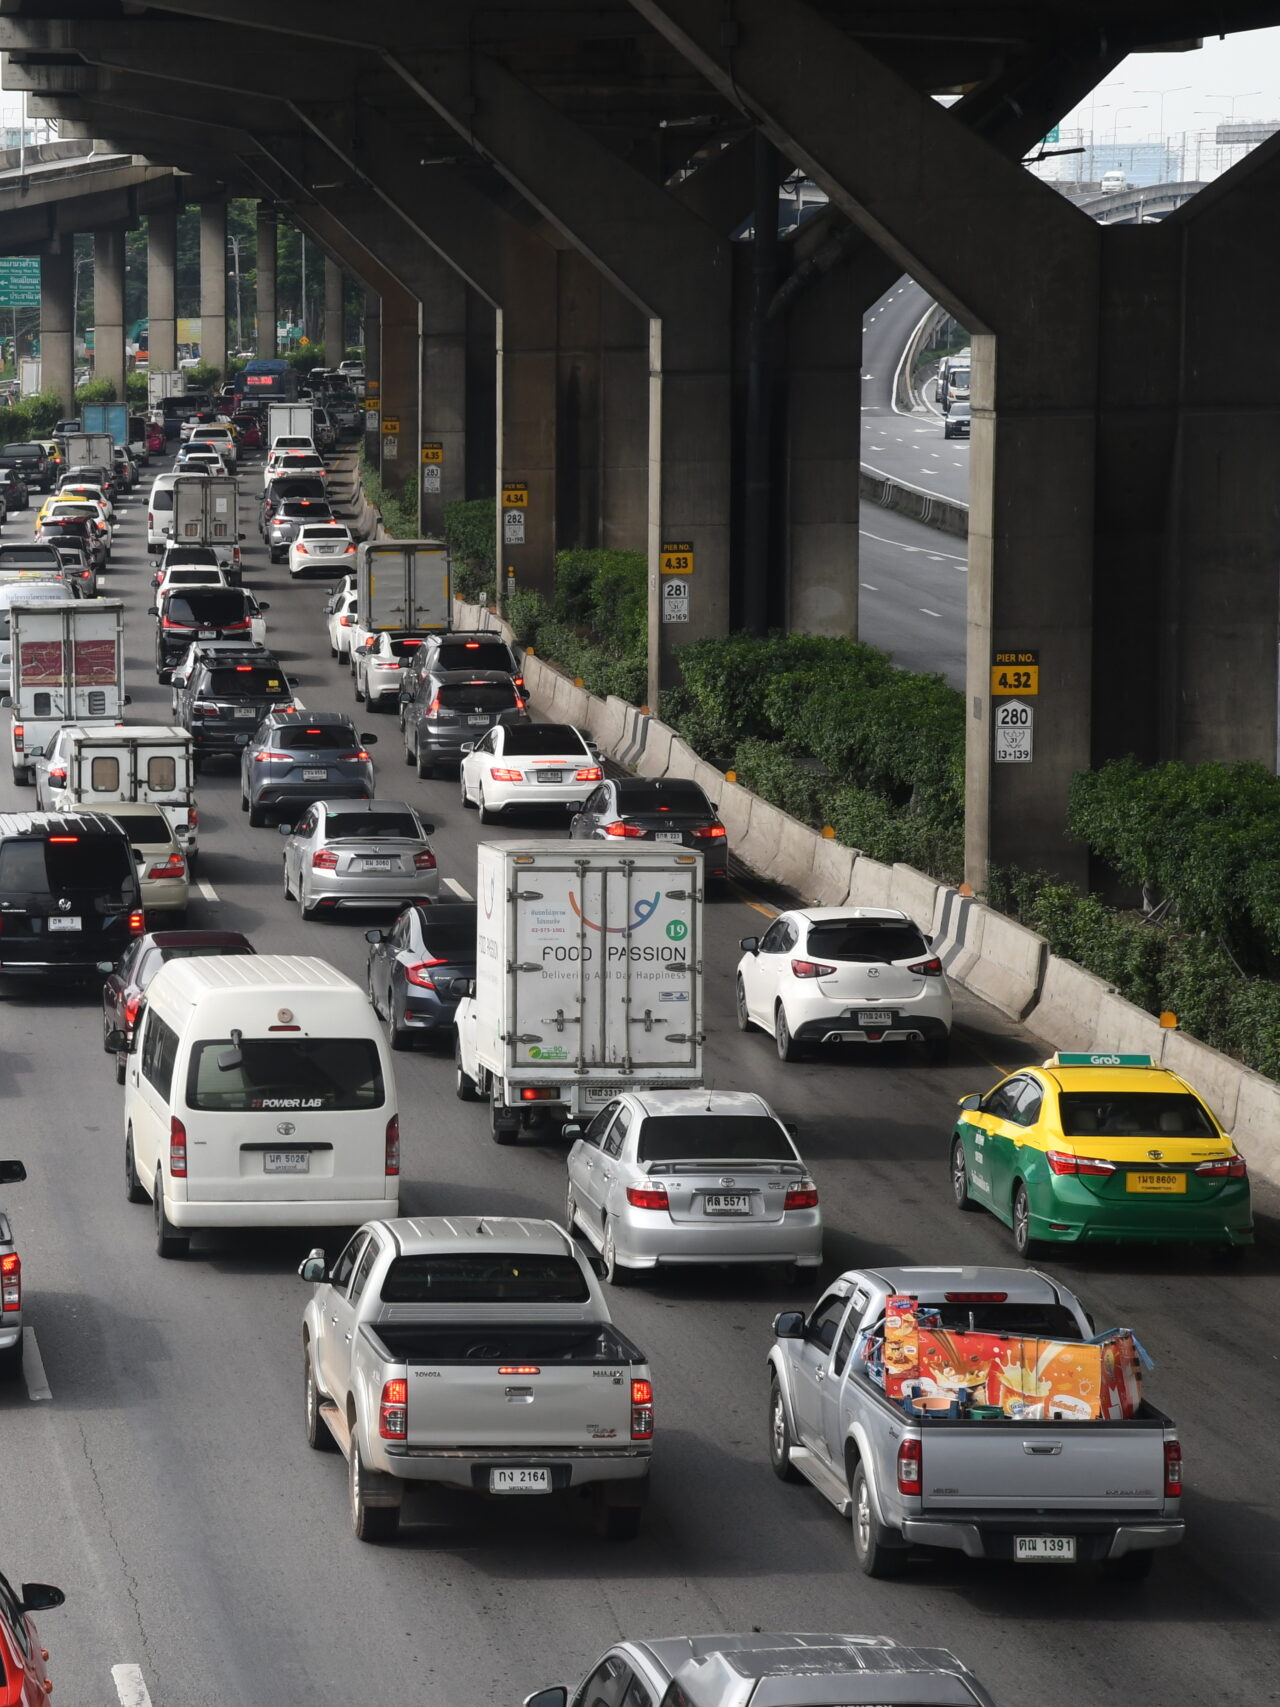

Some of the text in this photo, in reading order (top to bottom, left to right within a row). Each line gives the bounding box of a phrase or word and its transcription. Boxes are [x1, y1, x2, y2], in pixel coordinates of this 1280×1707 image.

[425, 452, 439, 460] 4.35
[506, 494, 524, 503] 4.34
[507, 514, 522, 523] 282
[665, 557, 688, 569] 4.33
[666, 585, 686, 596] 281
[996, 653, 1034, 662] PIER NO.
[998, 672, 1032, 689] 4.32
[1000, 708, 1028, 725] 280
[997, 750, 1029, 759] 13+139
[669, 924, 685, 937] 19
[542, 946, 686, 961] FOOD PASSION
[636, 970, 686, 981] Happiness
[1090, 1055, 1121, 1065] Grab
[301, 1099, 321, 1107] LAB
[285, 1154, 306, 1164] 5026
[1156, 1175, 1177, 1184] 8600
[723, 1196, 747, 1207] 5571
[519, 1471, 546, 1482] 2164
[1042, 1539, 1071, 1552] 1391
